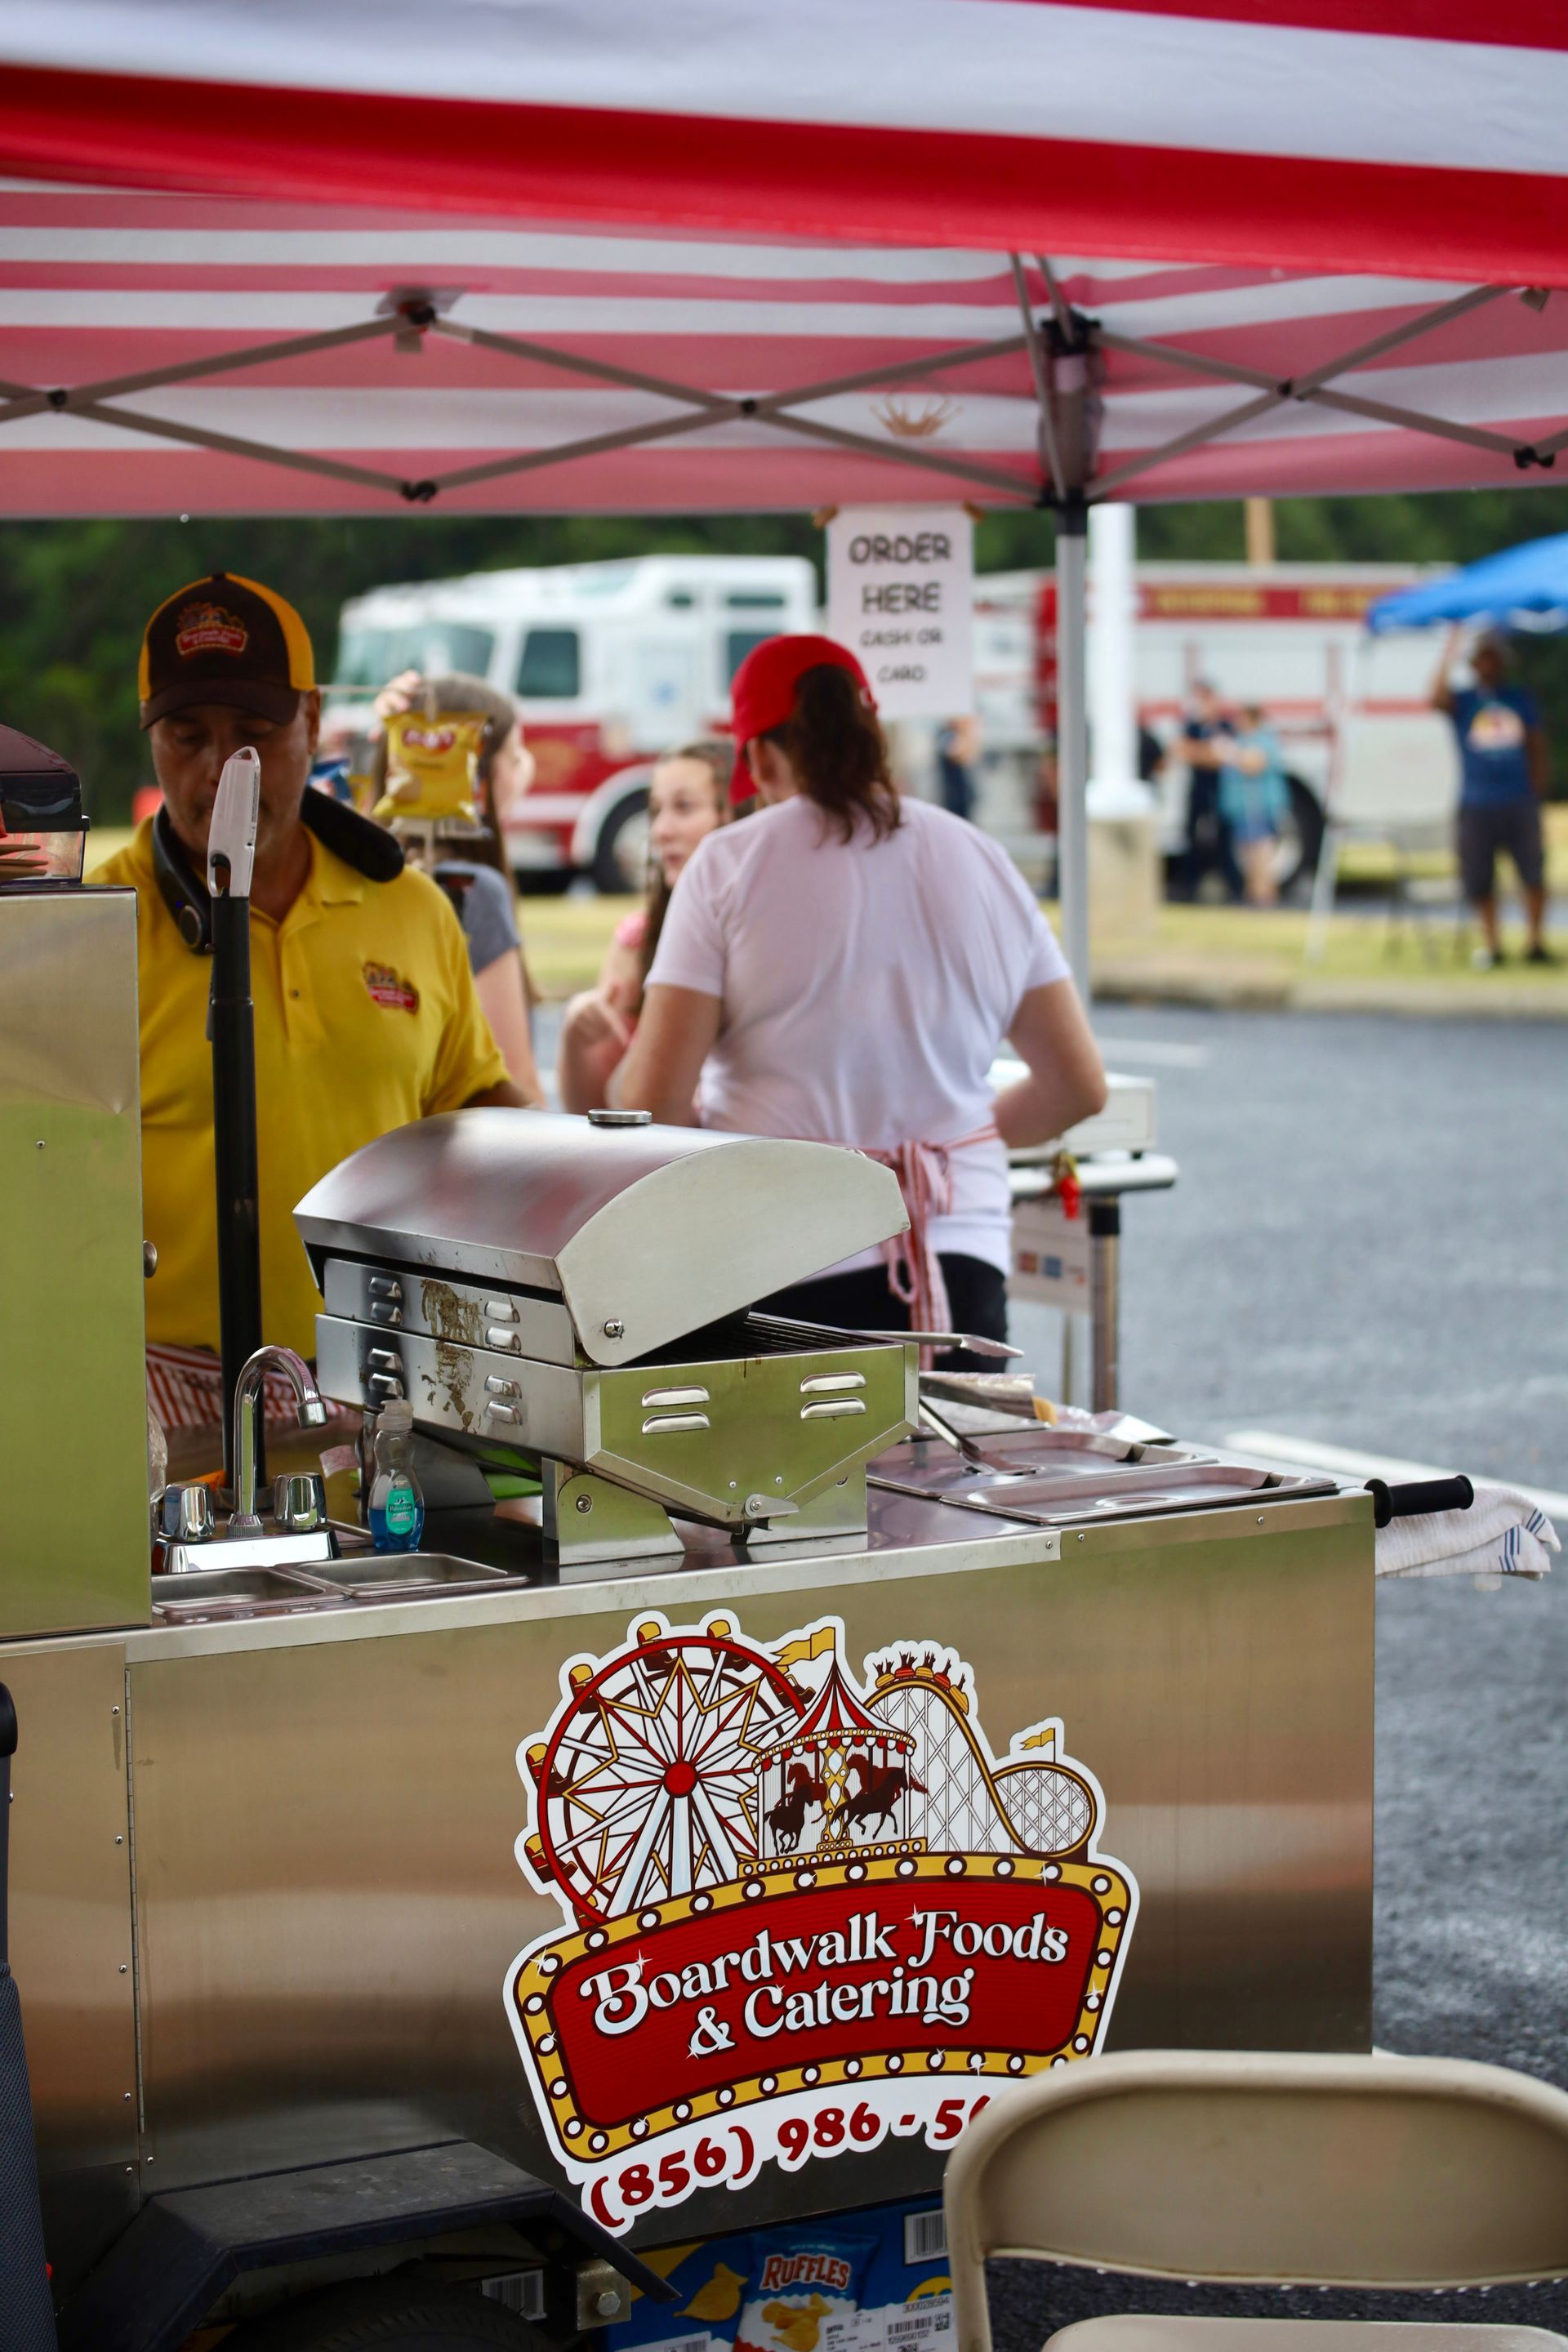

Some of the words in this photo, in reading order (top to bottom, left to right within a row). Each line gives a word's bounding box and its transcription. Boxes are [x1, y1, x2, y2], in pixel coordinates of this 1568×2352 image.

[849, 532, 951, 564] ORDER
[862, 582, 941, 612] HERE
[861, 629, 911, 647] CASH
[917, 627, 942, 644] OR
[877, 665, 926, 682] CARD
[579, 1912, 898, 2034] Boardwalk
[906, 1905, 1069, 1967] Foods
[687, 2006, 736, 2059] &
[744, 1967, 975, 2038] Catering
[590, 2125, 756, 2228] (856)
[760, 2252, 852, 2291] RUFFLES
